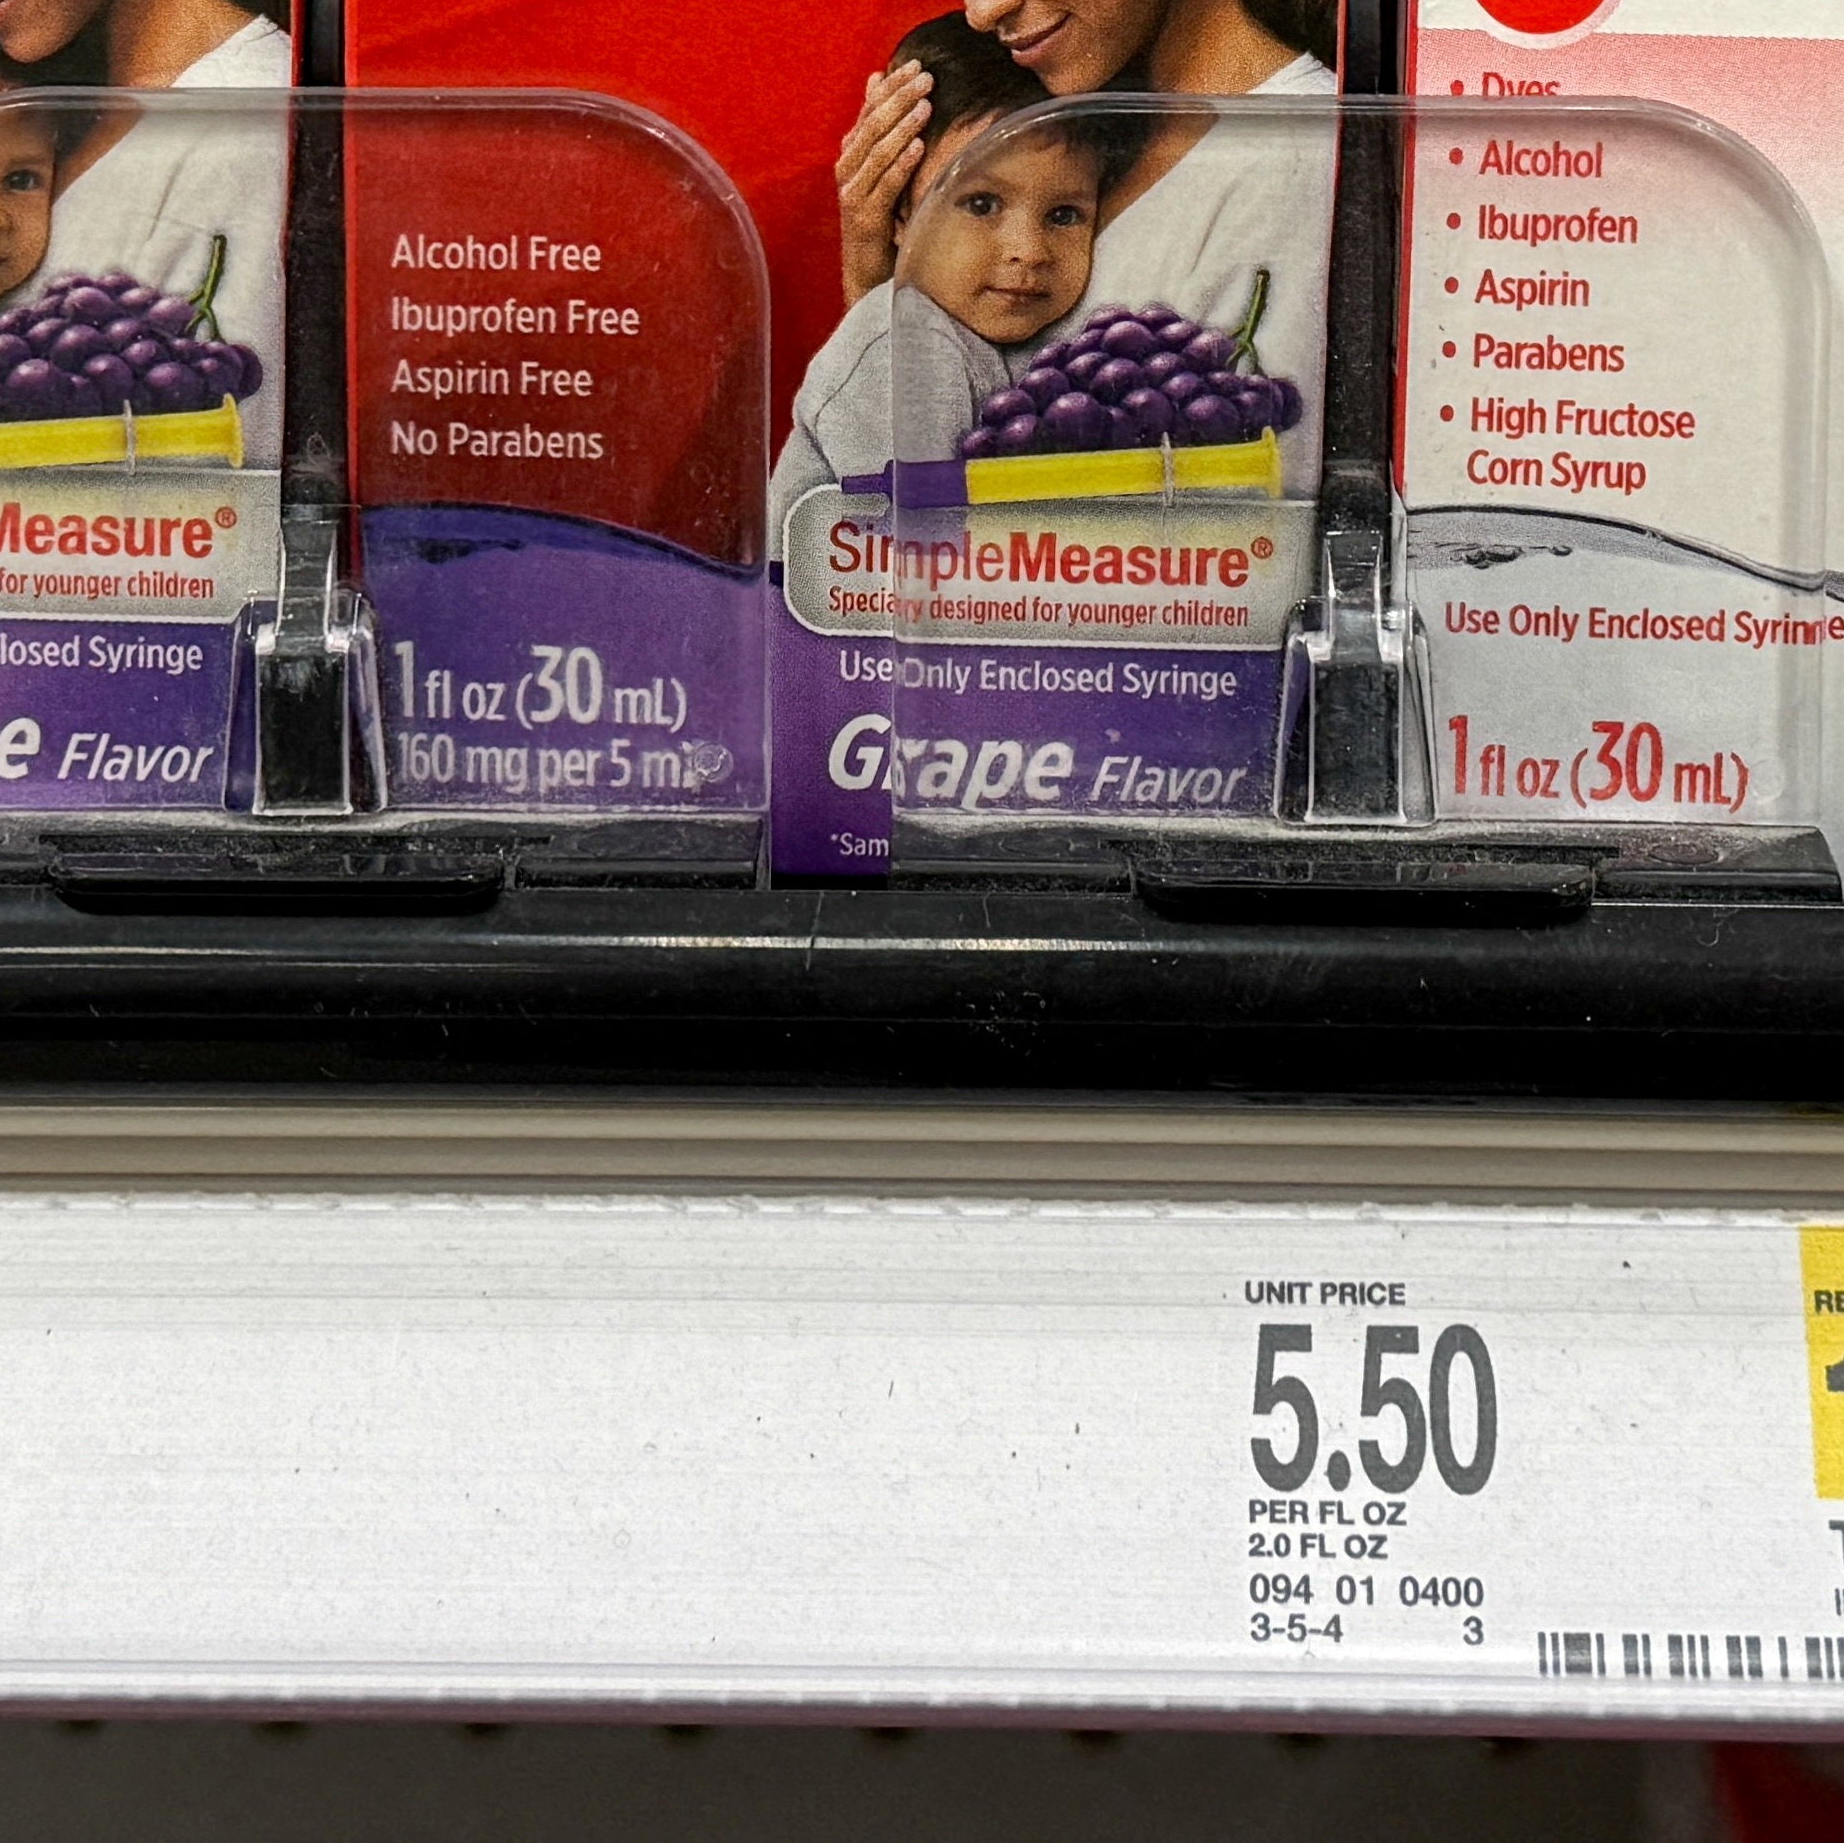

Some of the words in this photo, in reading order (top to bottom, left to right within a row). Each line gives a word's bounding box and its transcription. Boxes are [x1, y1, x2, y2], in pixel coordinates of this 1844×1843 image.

[1478, 139, 1604, 178] Alcohol
[1477, 204, 1638, 248] Ibuprofen
[1474, 269, 1590, 311] Aspirin
[1472, 332, 1625, 373] Parabens
[1470, 397, 1547, 442] High
[1555, 399, 1696, 440] Fructose
[1466, 449, 1543, 488] Corn
[1550, 451, 1647, 496] Syrup
[1444, 601, 1500, 635] Use
[1509, 603, 1580, 643] Only
[1588, 606, 1726, 643] Enclosed
[1244, 1280, 1314, 1306] UNIT
[1319, 1282, 1406, 1308] PRICE
[1249, 1321, 1498, 1496] 5.50
[1248, 1499, 1310, 1526] PER
[1318, 1500, 1354, 1526] FL
[1362, 1500, 1407, 1527] OZ
[1248, 1532, 1294, 1559] 2.0
[1299, 1533, 1336, 1559] FL
[1343, 1533, 1389, 1560] OZ
[1249, 1572, 1314, 1605] 094
[1335, 1574, 1375, 1606] 01
[1399, 1575, 1485, 1608] 0400
[1250, 1612, 1344, 1644] 3-5-4
[1463, 1615, 1485, 1646] 3
